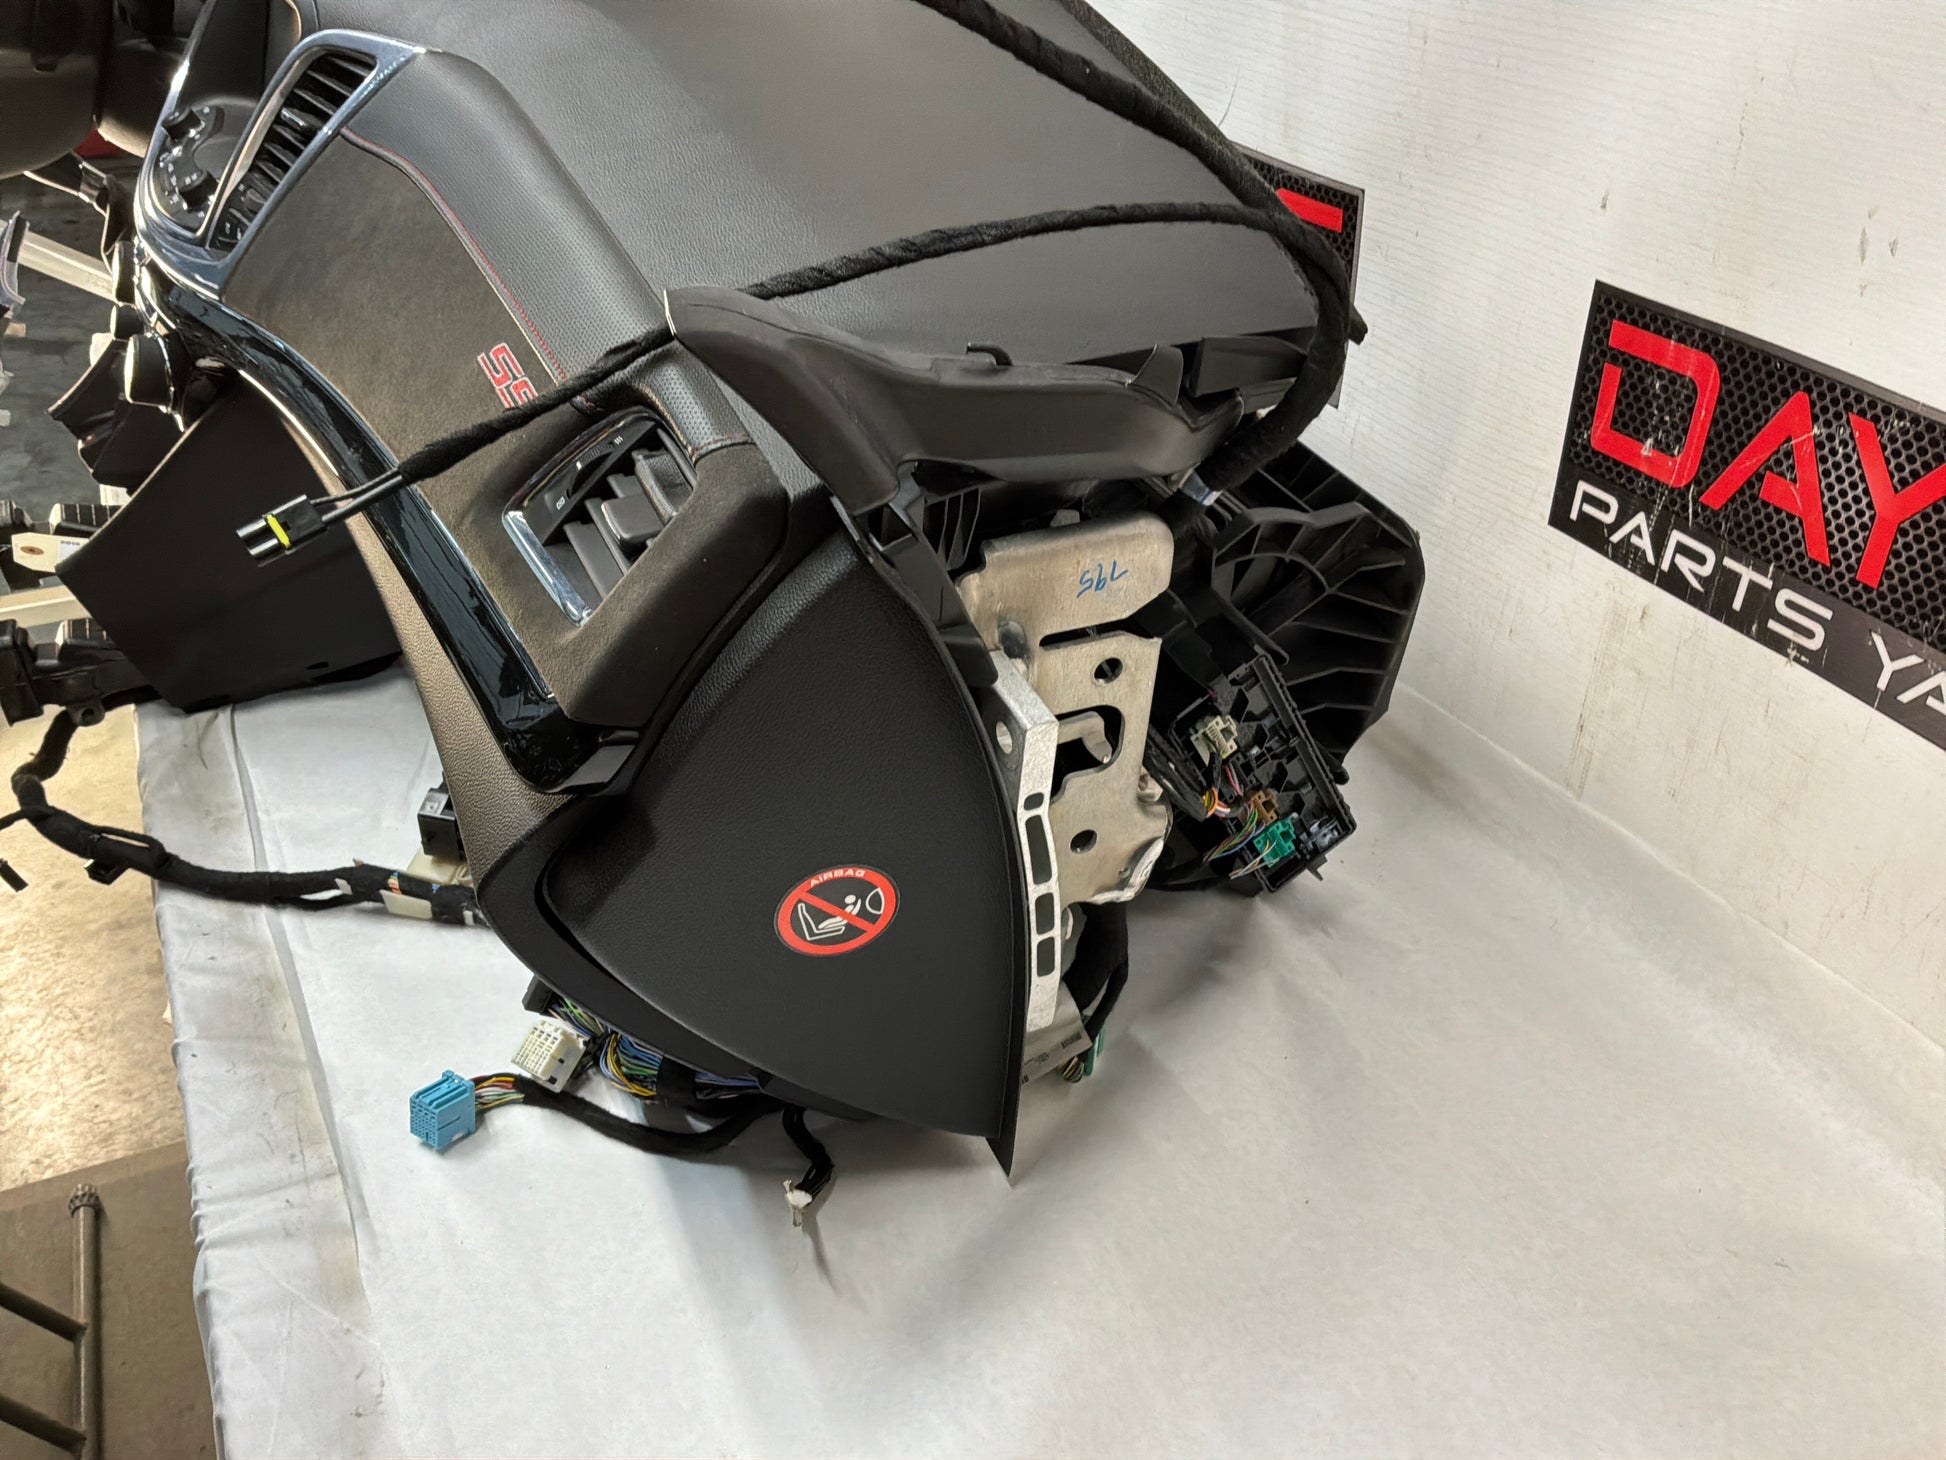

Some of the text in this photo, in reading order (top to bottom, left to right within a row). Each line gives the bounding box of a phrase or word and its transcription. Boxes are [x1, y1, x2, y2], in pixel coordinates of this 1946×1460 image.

[1590, 320, 1946, 589] DAY
[1569, 480, 1833, 651] PARTS
[810, 868, 865, 888] AIRBAG
